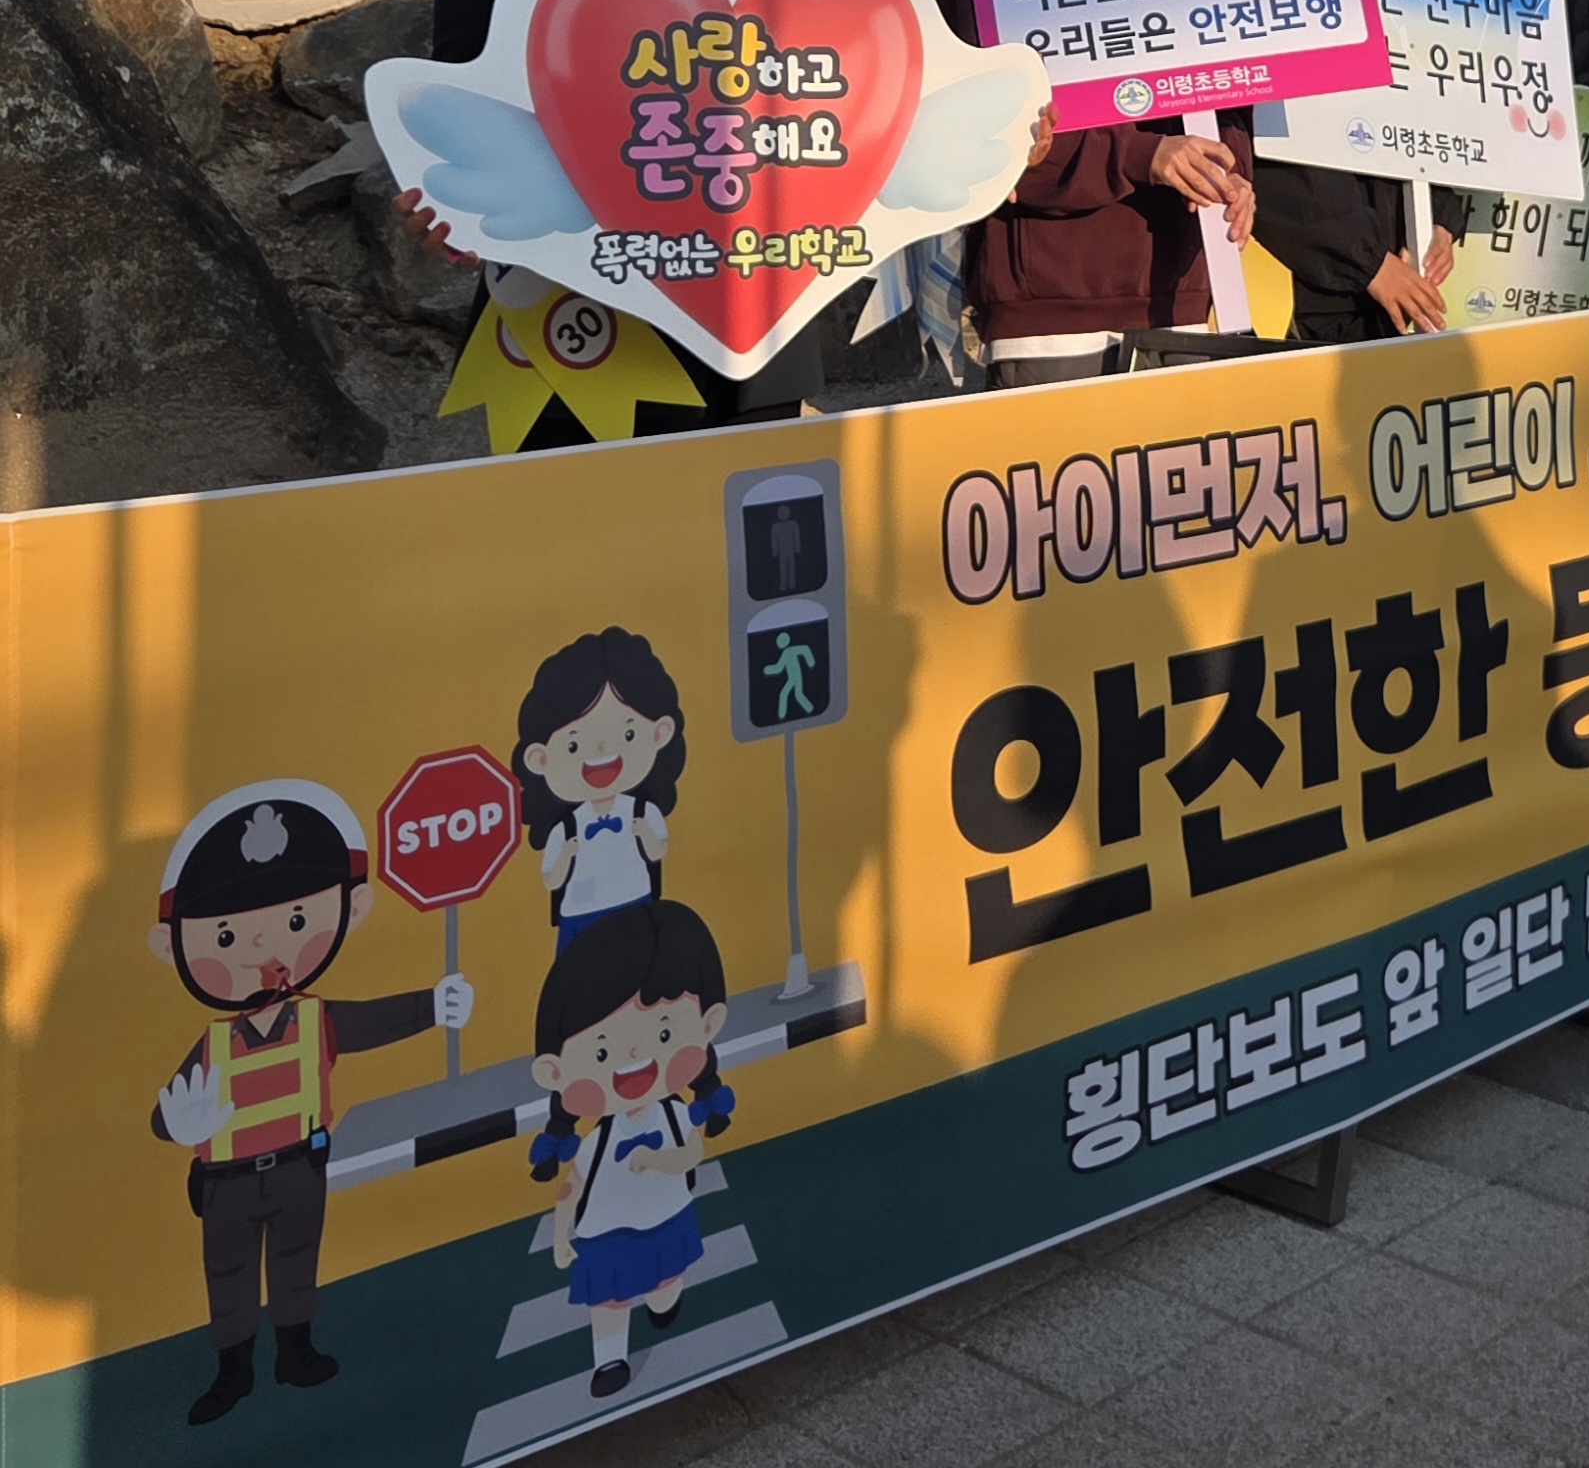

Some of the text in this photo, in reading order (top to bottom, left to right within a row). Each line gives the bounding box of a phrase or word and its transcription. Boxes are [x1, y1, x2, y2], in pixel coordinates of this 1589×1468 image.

[626, 17, 844, 99] 사랑하고
[1156, 65, 1271, 98] 의령초등학교
[1384, 35, 1553, 115] 는 우리우정
[1198, 88, 1243, 106] Elementary
[1244, 83, 1274, 100] School
[626, 98, 844, 207] 존중해요
[1381, 124, 1488, 166] 의령초등학교
[594, 227, 872, 282] 폭력없는 우리학교
[1489, 196, 1552, 258] 힘이
[556, 306, 604, 355] 30
[941, 418, 1348, 605] 아이먼저,
[1368, 378, 1575, 523] 어린이
[947, 580, 1509, 966] 안전한
[396, 799, 504, 855] STOP
[1064, 971, 1368, 1172] 횡단보도
[1381, 937, 1446, 1048] 앞
[1461, 884, 1574, 1012] 일단
